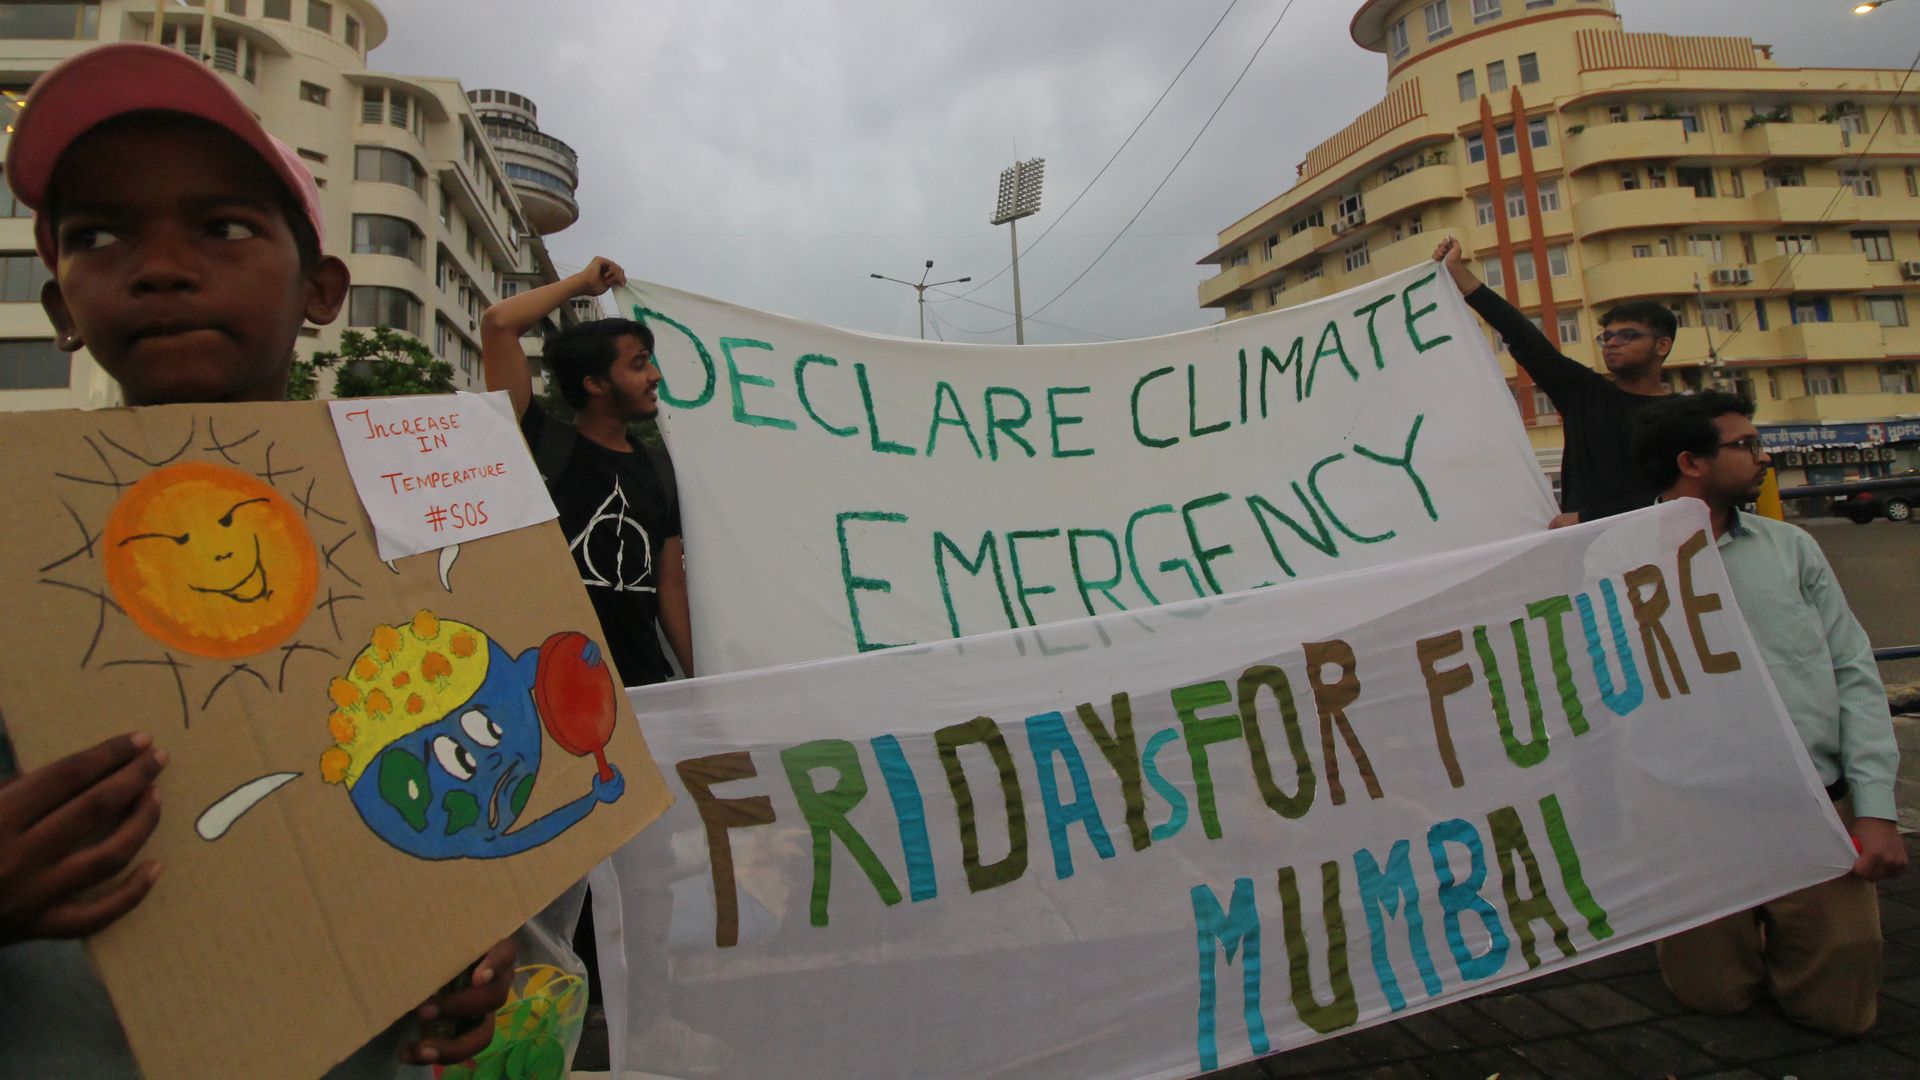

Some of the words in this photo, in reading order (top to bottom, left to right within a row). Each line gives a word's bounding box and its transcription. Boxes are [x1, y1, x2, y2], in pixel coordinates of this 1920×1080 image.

[416, 434, 448, 453] IN
[632, 303, 1095, 461] DECLARE
[1131, 272, 1452, 448] CLIMATE
[1887, 424, 1920, 437] HDFC
[424, 501, 489, 532] #SOS
[836, 413, 1438, 653] EMERGENCY
[1416, 529, 1741, 788] FUTURE
[1190, 794, 1614, 1071] MUMBAI
